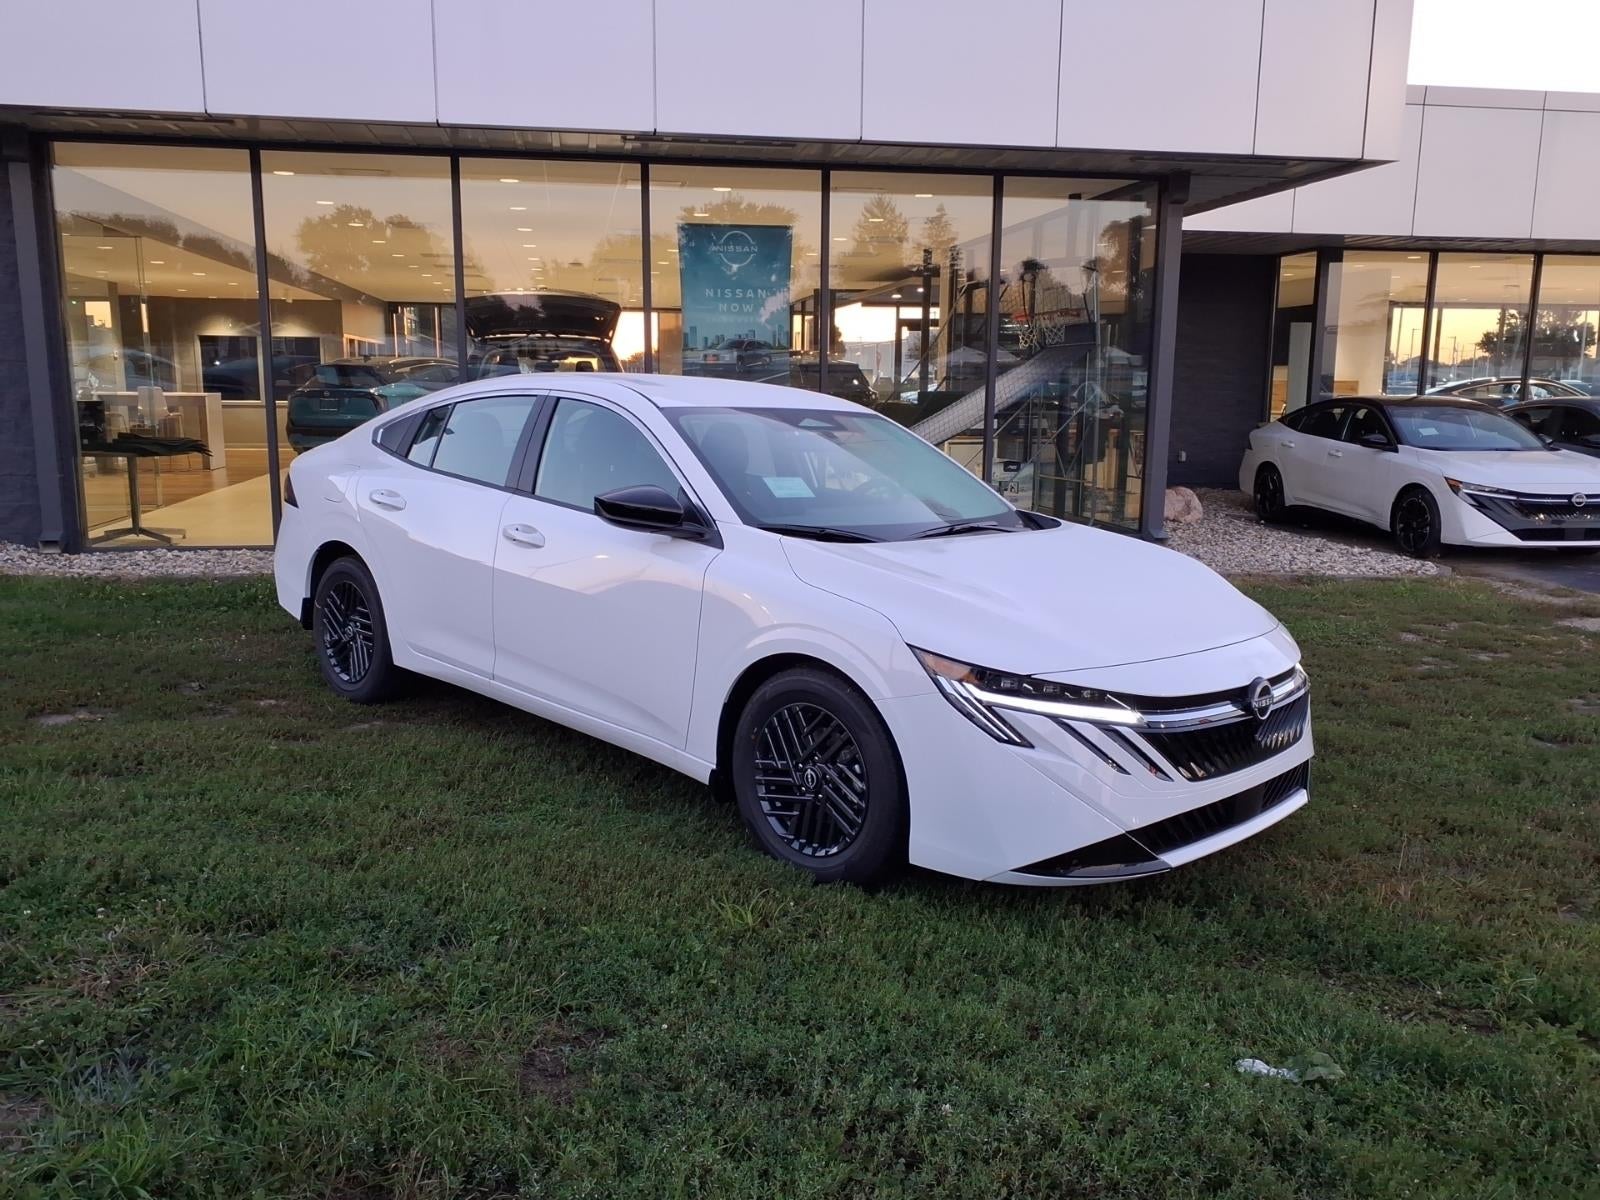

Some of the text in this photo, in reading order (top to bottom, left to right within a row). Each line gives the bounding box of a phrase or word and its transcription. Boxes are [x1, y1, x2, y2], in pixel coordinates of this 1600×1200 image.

[716, 245, 758, 253] NISSAN
[705, 288, 767, 299] NISSAN
[719, 303, 754, 313] NOW
[1252, 698, 1273, 708] NISS
